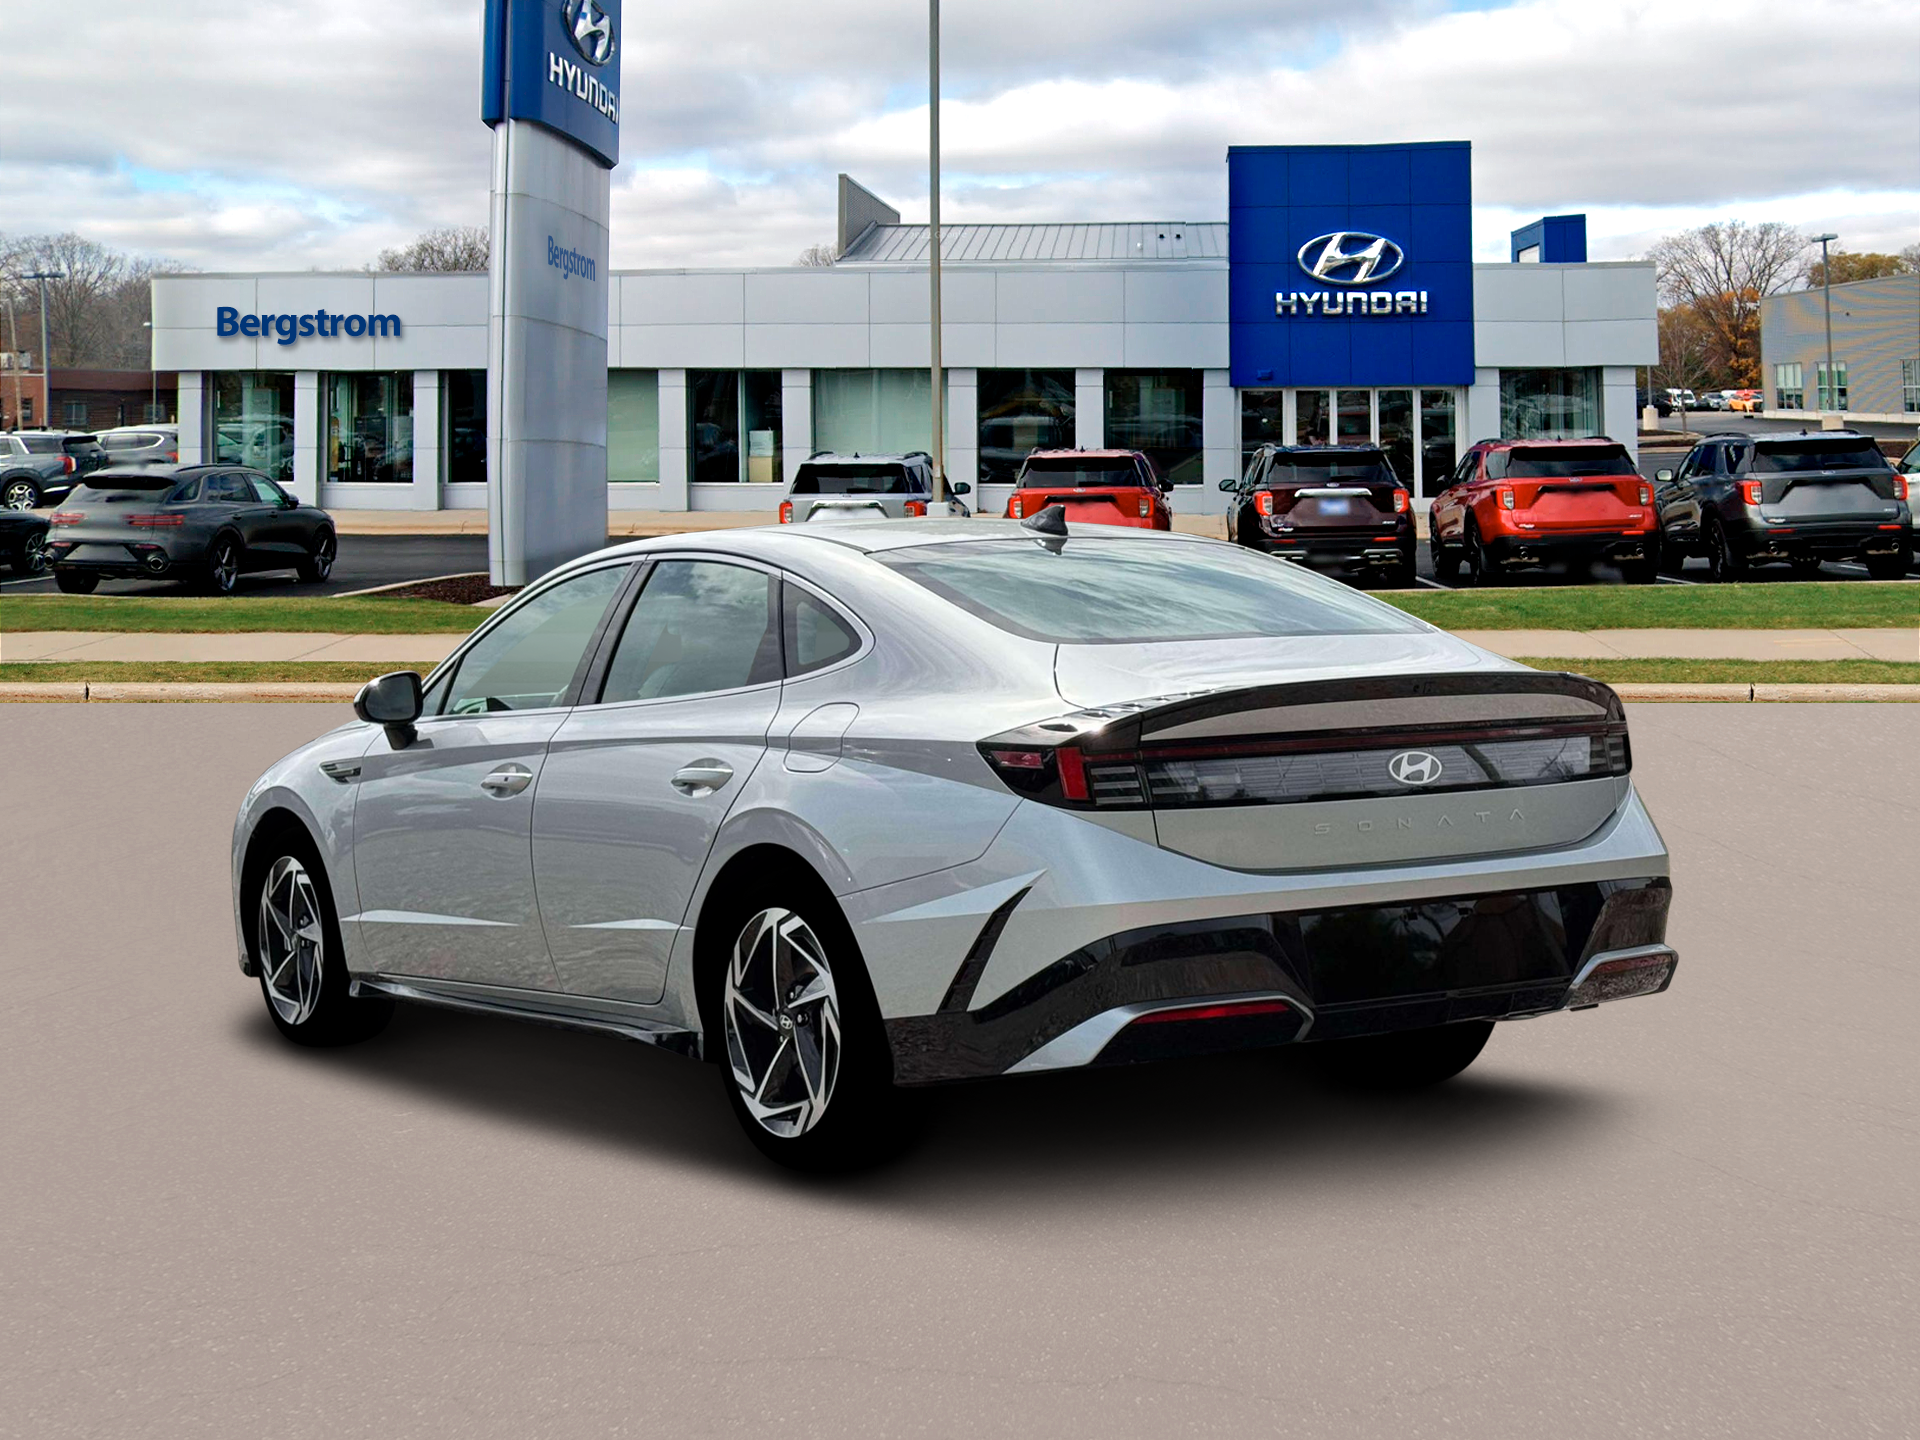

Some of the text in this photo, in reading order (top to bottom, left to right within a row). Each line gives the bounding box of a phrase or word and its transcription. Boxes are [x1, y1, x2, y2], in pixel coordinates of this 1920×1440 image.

[549, 52, 618, 124] HYUNDAI
[548, 235, 596, 282] Bergstrom
[1276, 291, 1428, 315] HYUNDAI
[217, 306, 401, 346] Bergstrom
[1314, 808, 1524, 835] SONATA
